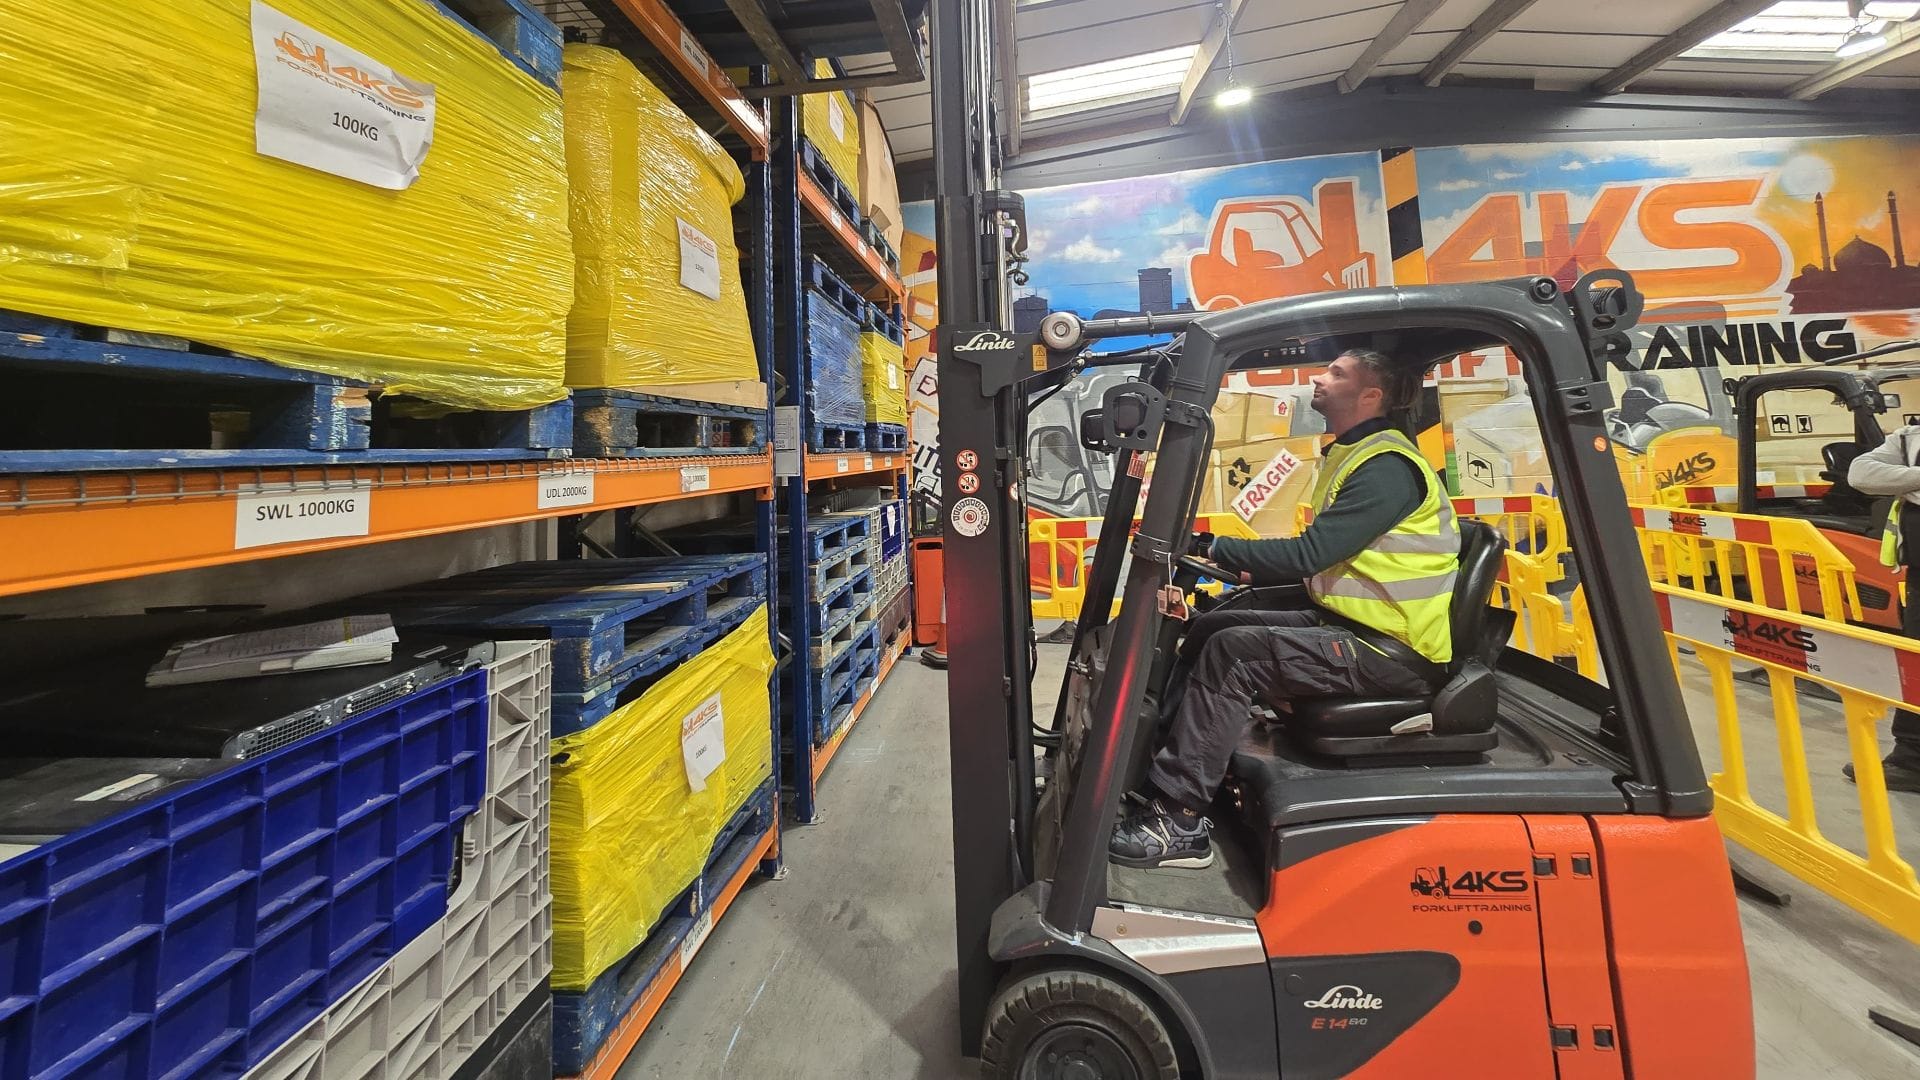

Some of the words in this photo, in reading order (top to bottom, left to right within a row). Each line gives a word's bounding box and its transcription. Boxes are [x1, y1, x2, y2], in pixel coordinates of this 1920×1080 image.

[331, 65, 425, 109] 4KS
[332, 111, 379, 142] 100KG
[1426, 175, 1783, 297] 4KS
[953, 332, 1016, 352] Linde
[1674, 451, 1716, 482] 4KS
[546, 488, 561, 499] UDL
[562, 485, 587, 497] 2000KG
[1238, 453, 1297, 517] FRAGILE
[256, 503, 294, 522] SWL
[298, 499, 355, 518] 1000KG
[1754, 621, 1818, 653] 4KS
[1452, 870, 1528, 893] 4KS
[1303, 984, 1383, 1010] Linde
